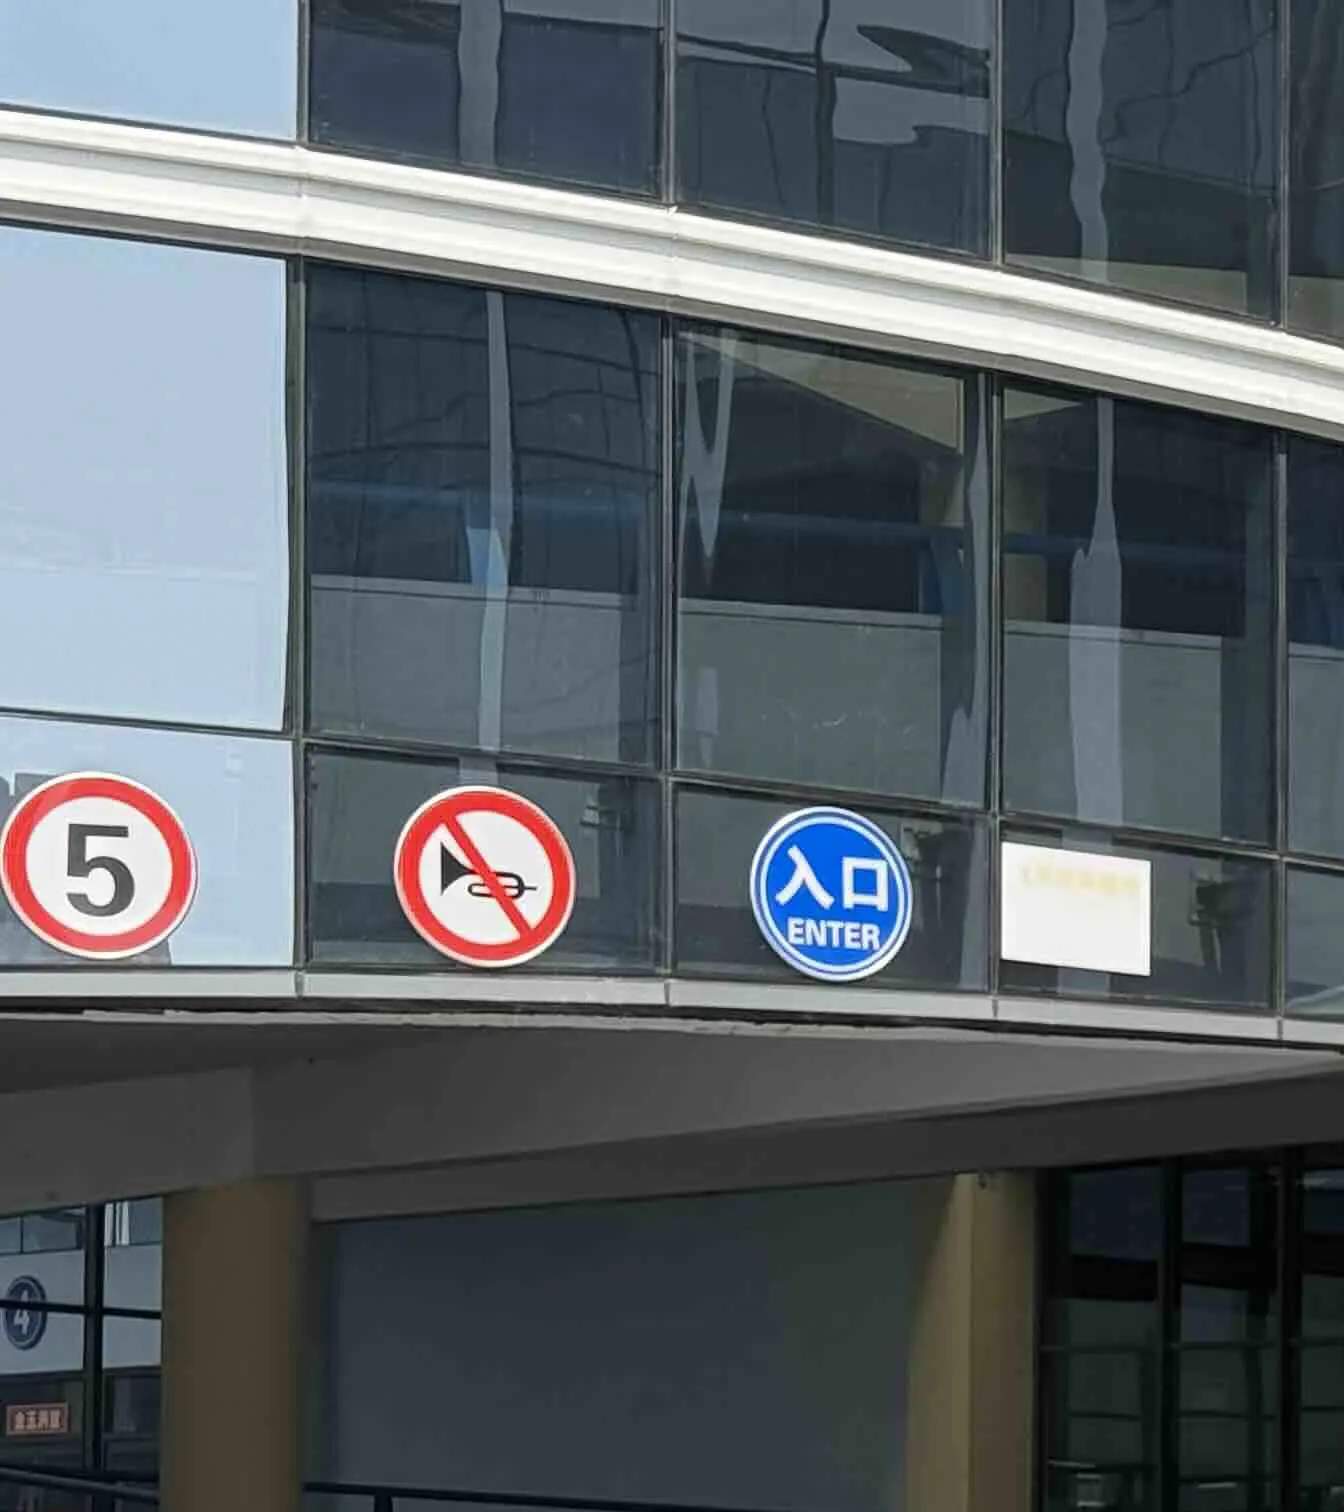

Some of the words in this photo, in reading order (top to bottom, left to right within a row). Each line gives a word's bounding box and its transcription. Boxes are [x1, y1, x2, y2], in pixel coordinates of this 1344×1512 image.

[66, 823, 135, 917] 5
[775, 844, 889, 912] 入口
[786, 916, 881, 951] ENTER
